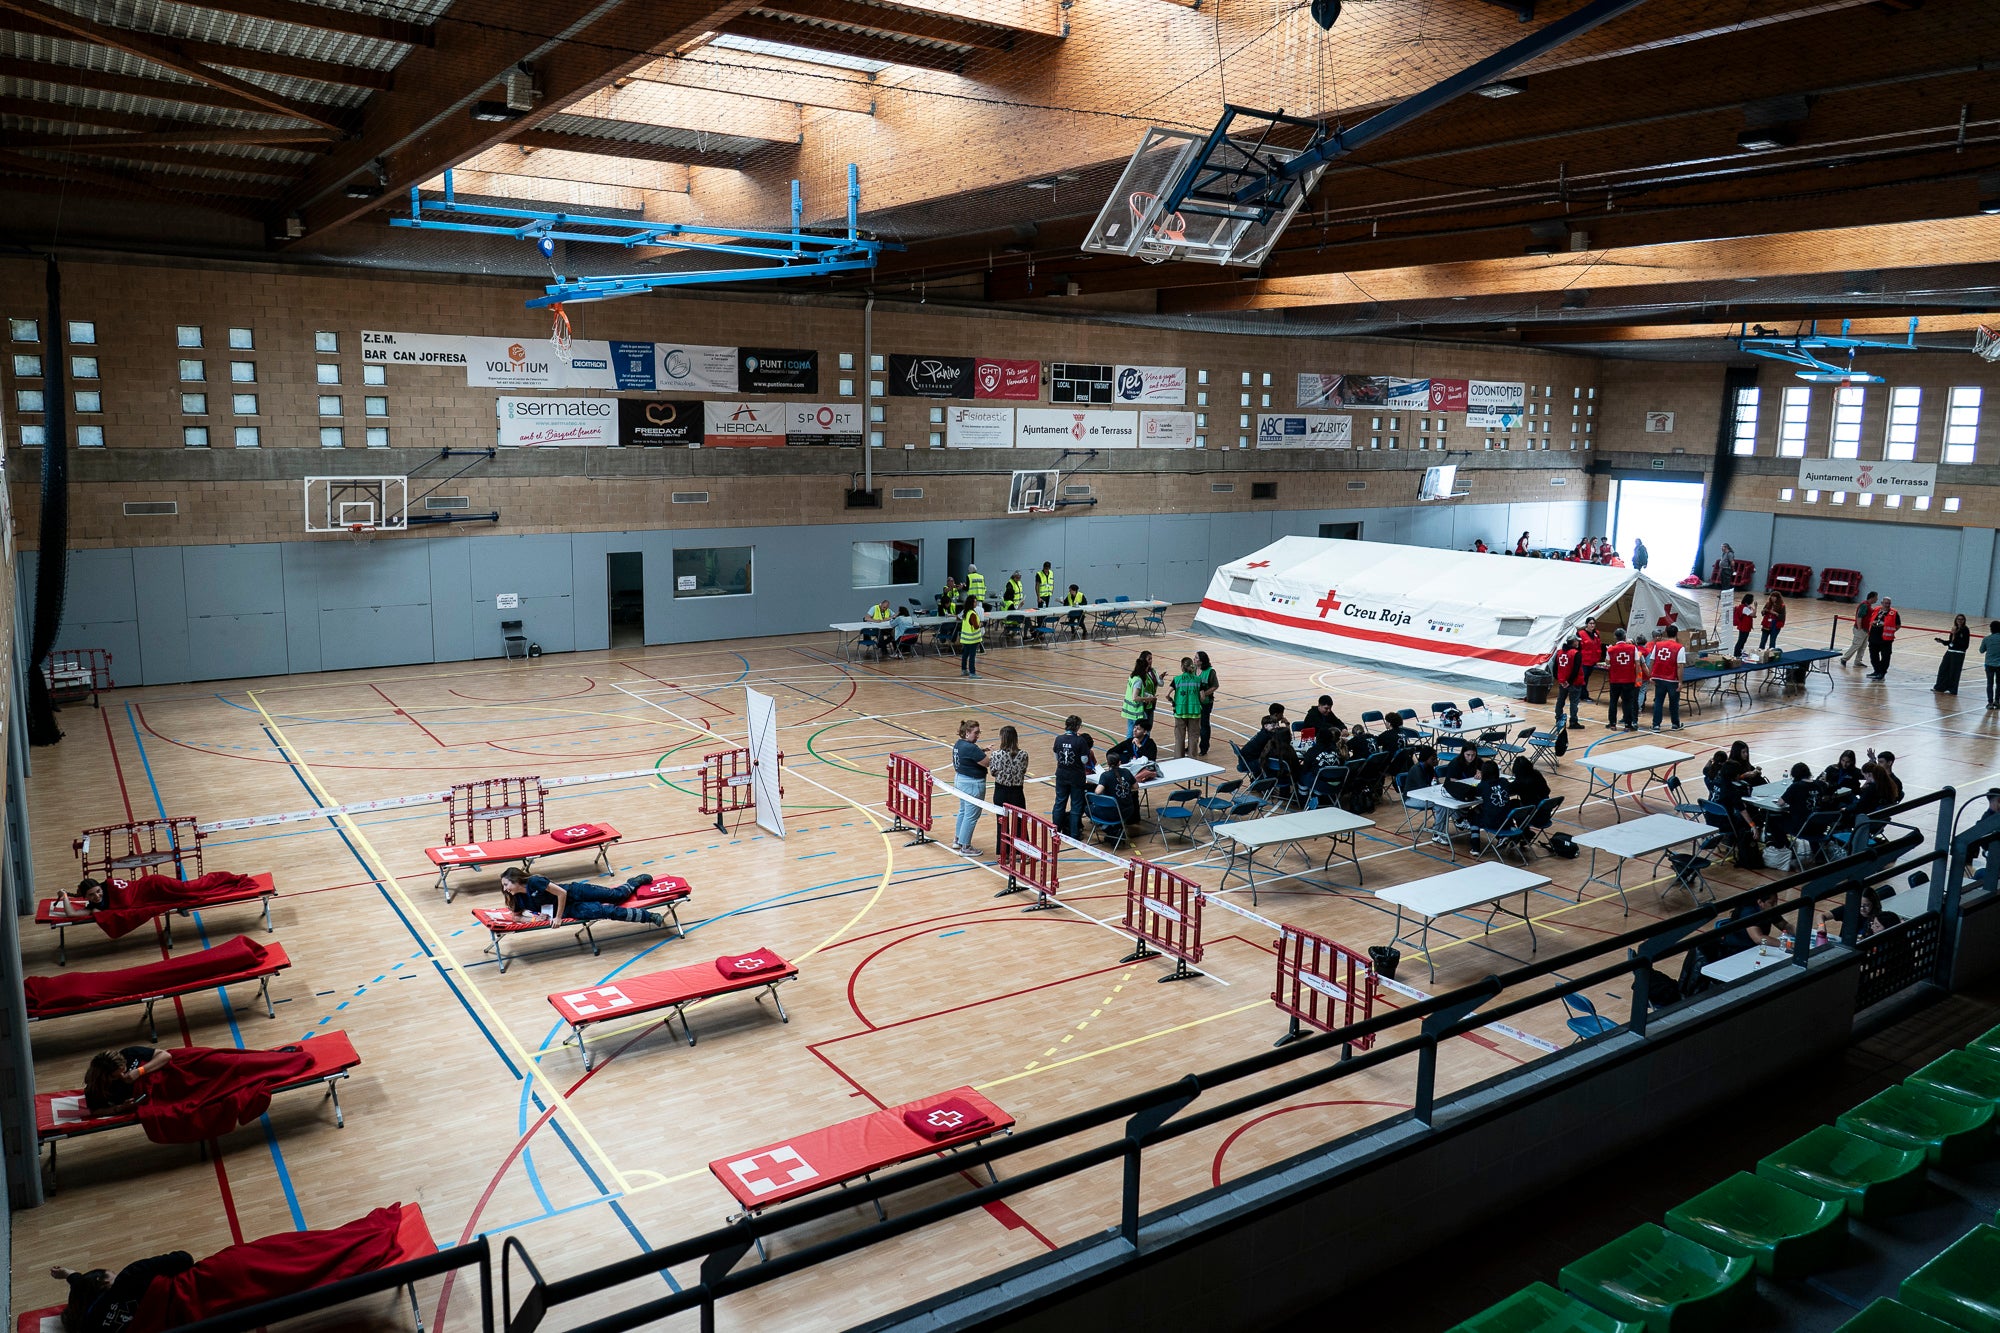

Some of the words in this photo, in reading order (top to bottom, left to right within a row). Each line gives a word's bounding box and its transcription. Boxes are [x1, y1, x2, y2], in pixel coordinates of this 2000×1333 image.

[364, 334, 396, 344] Z.E.M.
[365, 350, 386, 359] BAR
[393, 351, 415, 360] CAN
[419, 353, 466, 362] JOFRESA
[486, 362, 548, 373] VOLTTIUM
[760, 360, 782, 368] PUNT
[906, 359, 919, 390] Al
[920, 360, 960, 383] Panino
[1117, 369, 1142, 397] jet
[1471, 385, 1522, 399] ODONTOMED
[517, 401, 610, 416] sermatec
[716, 423, 772, 432] HERCAL
[1022, 425, 1068, 435] Ajuntament
[1090, 426, 1098, 434] de
[1101, 426, 1132, 435] Terrassa
[1260, 418, 1282, 435] ABC
[1806, 473, 1853, 482] Ajuntament
[1890, 477, 1929, 486] Terrassa
[1343, 604, 1376, 620] Creu
[1379, 609, 1412, 626] Roja
